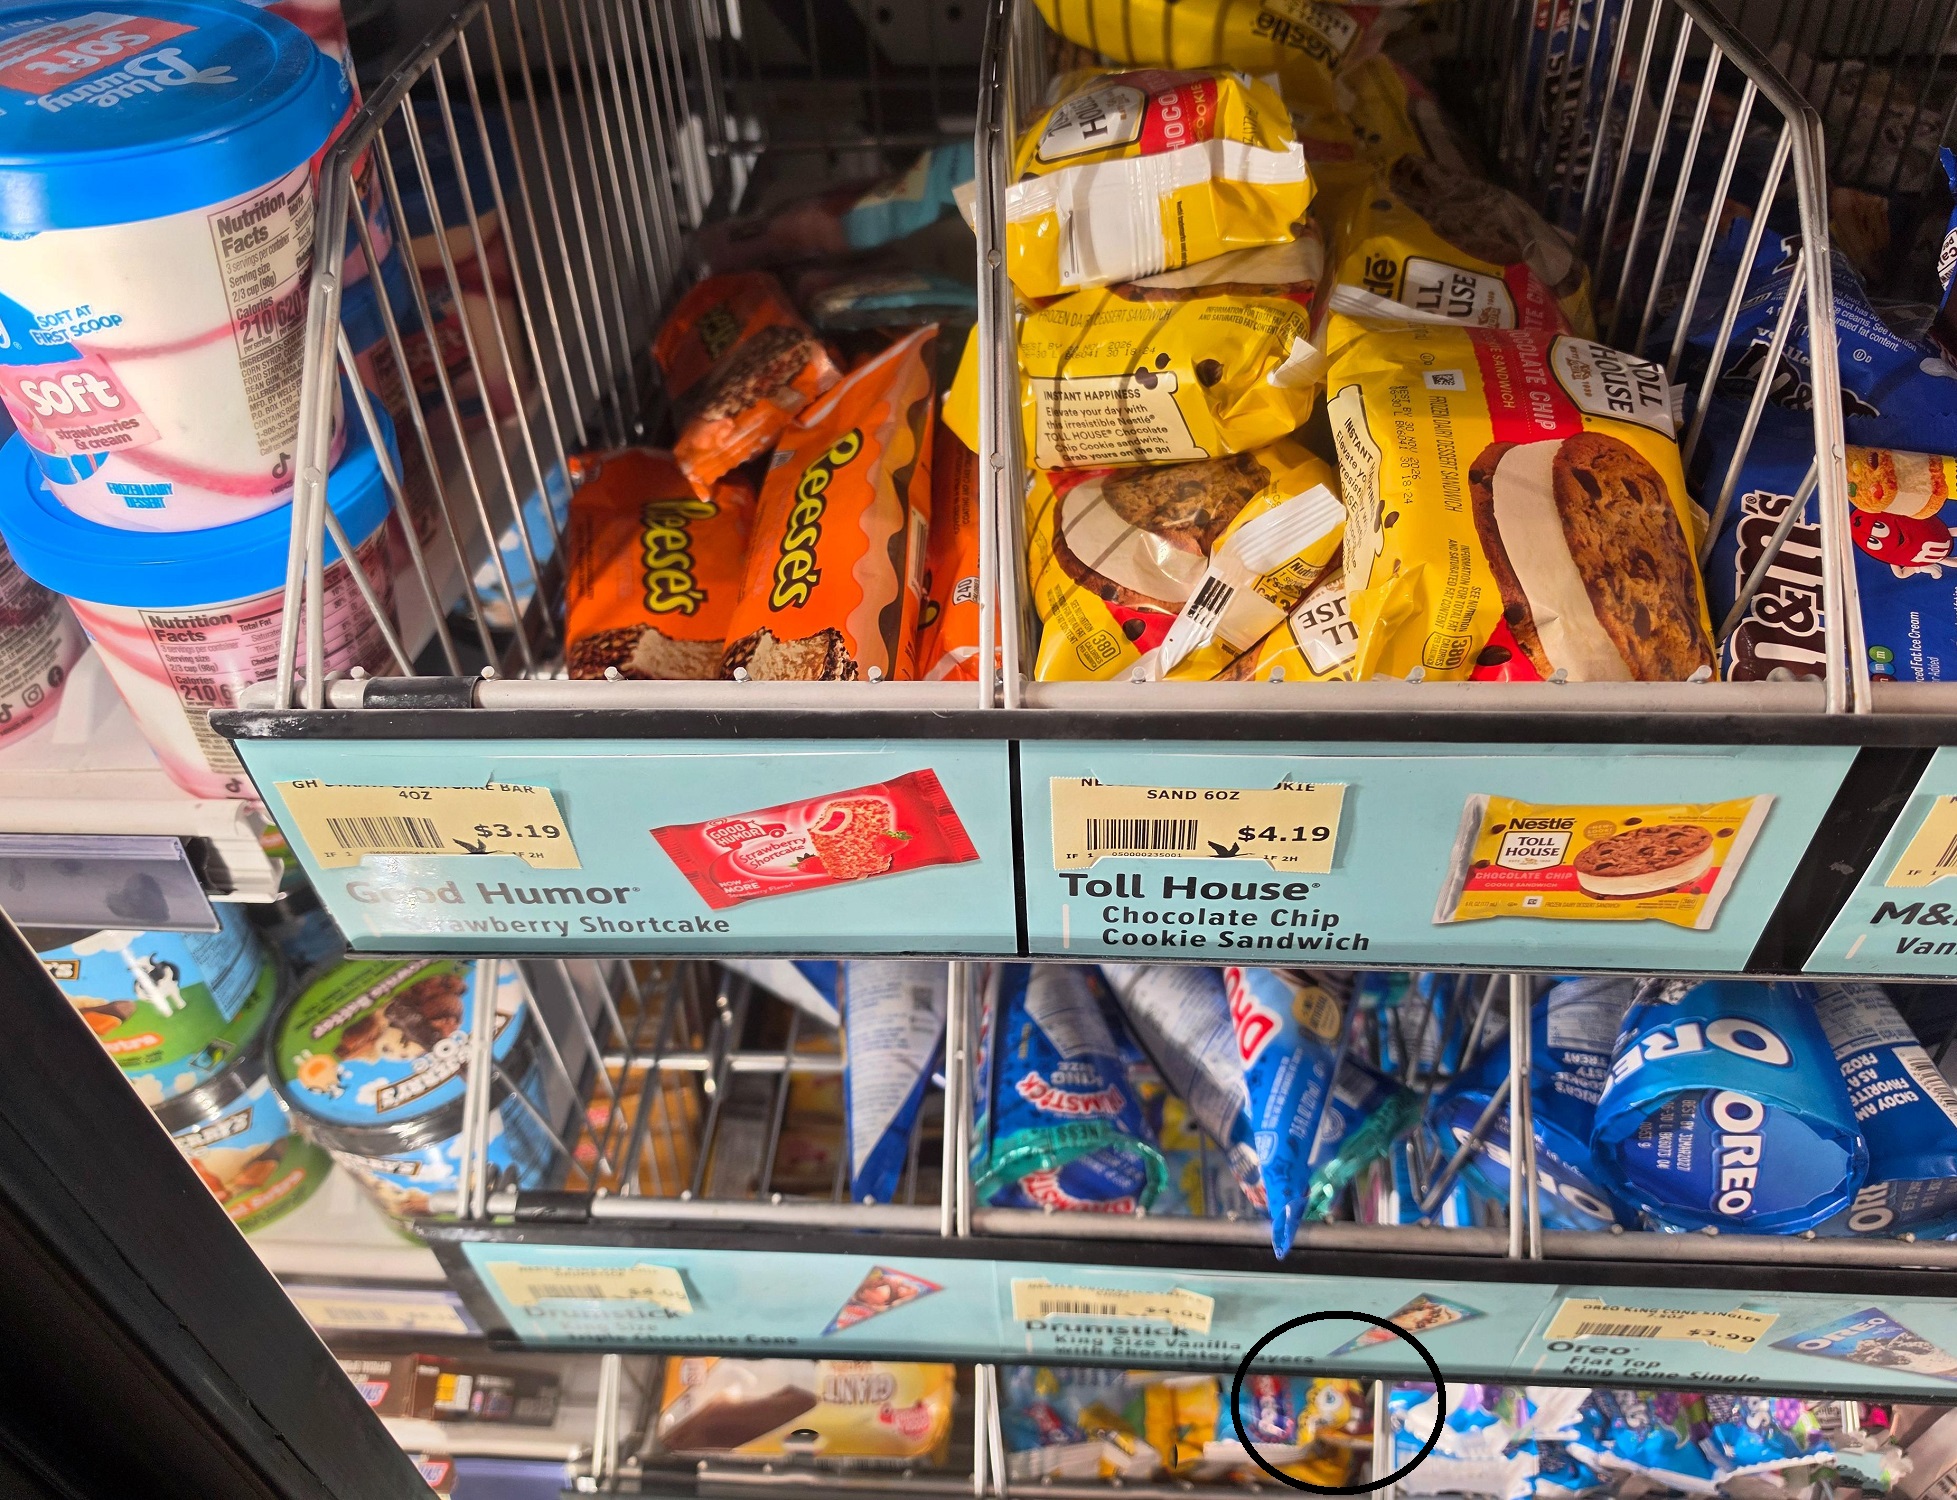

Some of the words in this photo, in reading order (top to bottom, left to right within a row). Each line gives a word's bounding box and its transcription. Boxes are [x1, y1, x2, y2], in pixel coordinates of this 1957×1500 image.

[217, 192, 286, 238] Nutrition
[222, 226, 269, 258] Facts
[233, 255, 259, 272] servings
[259, 248, 268, 262] per
[268, 233, 290, 255] container
[229, 270, 257, 288] Serving
[258, 262, 271, 275] size
[232, 287, 245, 302] 2/3
[247, 283, 259, 299] cup
[260, 271, 276, 291] (98g)
[37, 309, 73, 328] SOFT
[75, 304, 93, 317] AT
[237, 296, 273, 320] Calories
[240, 309, 274, 345] 210
[276, 290, 301, 326] 620
[32, 328, 70, 344] FIRST
[74, 314, 123, 337] SCOOP
[1841, 309, 1871, 327] creams.
[1873, 321, 1888, 334] See
[1869, 333, 1899, 352] content.
[239, 343, 284, 369] INGREDIENTS:
[242, 363, 261, 378] CORN
[243, 373, 262, 387] FOOD
[1588, 344, 1634, 414] HOUSE
[1044, 390, 1082, 401] INSTANT
[1084, 388, 1141, 401] HAPPINESS
[265, 403, 279, 415] BOX
[1046, 406, 1079, 417] Elevate
[1080, 408, 1102, 418] your
[1104, 406, 1122, 418] day
[1125, 404, 1148, 415] with
[1428, 395, 1450, 418] FROZEN
[1529, 392, 1557, 430] CHIP
[56, 417, 140, 440] strawberries
[254, 409, 286, 430] CONTAINS
[1046, 420, 1063, 430] this
[1065, 418, 1116, 430] irresistible
[1433, 419, 1453, 439] DAIRY
[74, 437, 88, 450] &
[89, 433, 133, 449] cream
[1044, 431, 1071, 442] TOLL
[1115, 426, 1168, 438] Chocolate
[1344, 417, 1373, 464] INSTANT
[1080, 440, 1115, 451] Cookie
[1117, 437, 1168, 448] sandwich.
[1336, 430, 1361, 470] Elevate
[1408, 437, 1418, 453] NOV
[1064, 452, 1088, 462] Grab
[1089, 451, 1118, 461] yours
[1120, 449, 1133, 457] on
[1134, 446, 1153, 456] the
[1436, 440, 1458, 471] DESSERT
[1410, 457, 1421, 480] 2026
[106, 482, 142, 495] FROZEN
[144, 482, 173, 495] DAIRY
[1402, 475, 1413, 505] 18:24
[1441, 471, 1463, 513] SANDWICH
[124, 497, 165, 509] DESSERT
[1460, 544, 1471, 586] INFORMATION
[1458, 586, 1468, 599] FOR
[1471, 586, 1481, 599] SEE
[1435, 599, 1451, 629] CONTENT
[1450, 601, 1464, 620] TOTAL
[1459, 600, 1478, 632] NUTRITION
[148, 614, 233, 628] Nutrition
[240, 622, 258, 632] Total
[260, 618, 272, 627] Fat
[1446, 620, 1459, 632] FAT
[1908, 611, 1921, 638] Cream
[154, 630, 207, 642] Facts
[1909, 639, 1922, 651] Ice
[1093, 634, 1117, 659] 380
[1435, 639, 1451, 667] CALORIES
[1446, 639, 1467, 666] 380
[166, 655, 195, 665] Serving
[1910, 651, 1923, 666] Fat
[176, 675, 215, 685] Calories
[181, 685, 217, 701] 210
[292, 780, 319, 790] GH
[1147, 789, 1197, 800] SAND
[473, 824, 561, 840] $3.19
[711, 823, 746, 839] GOOD
[717, 829, 761, 845] HUMOR
[1238, 826, 1330, 842] $4.19
[739, 837, 807, 863] Strawberry
[1518, 836, 1555, 847] TOLL
[750, 844, 805, 869] Shortcake
[1505, 847, 1560, 857] HOUSE
[719, 879, 742, 888] NOW
[1475, 871, 1540, 880] CHOCOLATE
[1545, 872, 1573, 880] CHIP
[475, 881, 631, 906] Humor
[724, 882, 761, 893] MORE
[1059, 873, 1145, 898] Toll
[1163, 876, 1310, 901] House
[579, 915, 730, 934] Shortcake
[1103, 906, 1258, 927] Chocolate
[1270, 908, 1340, 930] Chip
[1102, 928, 1206, 948] Cookie
[1218, 931, 1370, 951] Sandwich
[1600, 1016, 1792, 1100] ORE
[1878, 1090, 1919, 1112] ENJOY
[1713, 1091, 1764, 1214] OREO
[524, 1306, 681, 1320] Drumstick
[1026, 1320, 1190, 1337] Drumstick
[1687, 1328, 1756, 1343] $3.99
[1797, 1317, 1887, 1351] OREO
[1055, 1335, 1104, 1347] King
[1112, 1336, 1156, 1348] Size
[1165, 1338, 1241, 1351] Vanilla
[1547, 1341, 1630, 1356] Oreo
[1569, 1356, 1613, 1367] Flat
[1623, 1358, 1661, 1369] Top
[1563, 1366, 1613, 1378] King
[1623, 1368, 1680, 1380] Cone
[1687, 1372, 1761, 1384] Single
